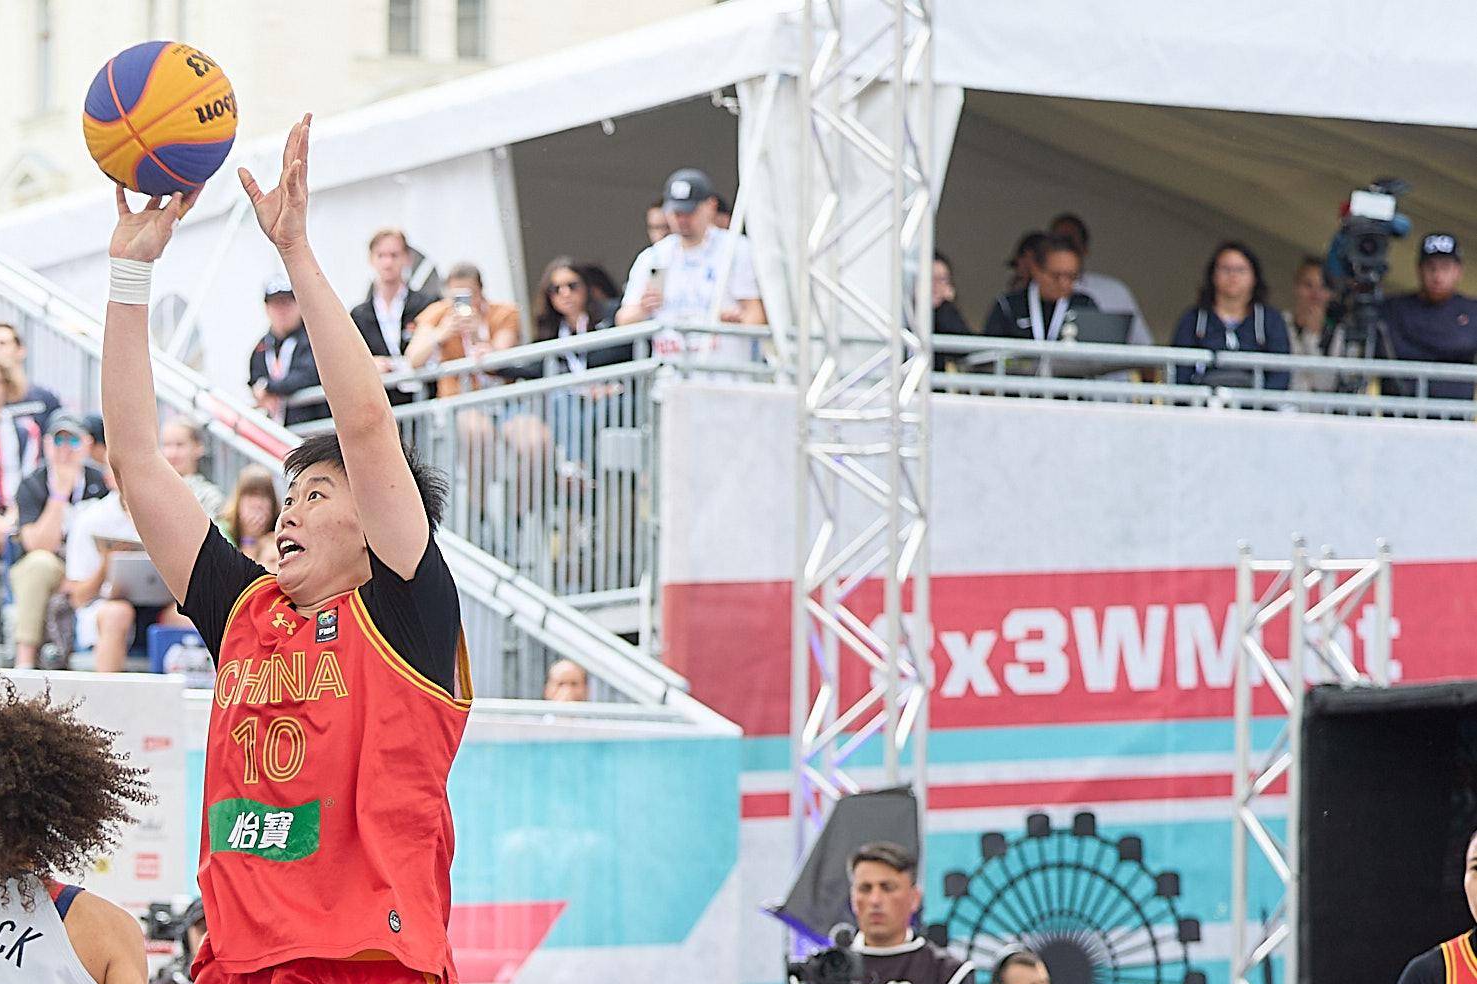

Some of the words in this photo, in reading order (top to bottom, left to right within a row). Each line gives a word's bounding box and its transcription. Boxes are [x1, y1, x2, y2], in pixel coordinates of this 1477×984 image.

[215, 651, 349, 709] CHINA
[231, 716, 306, 785] 10
[227, 810, 294, 850] 怡寶
